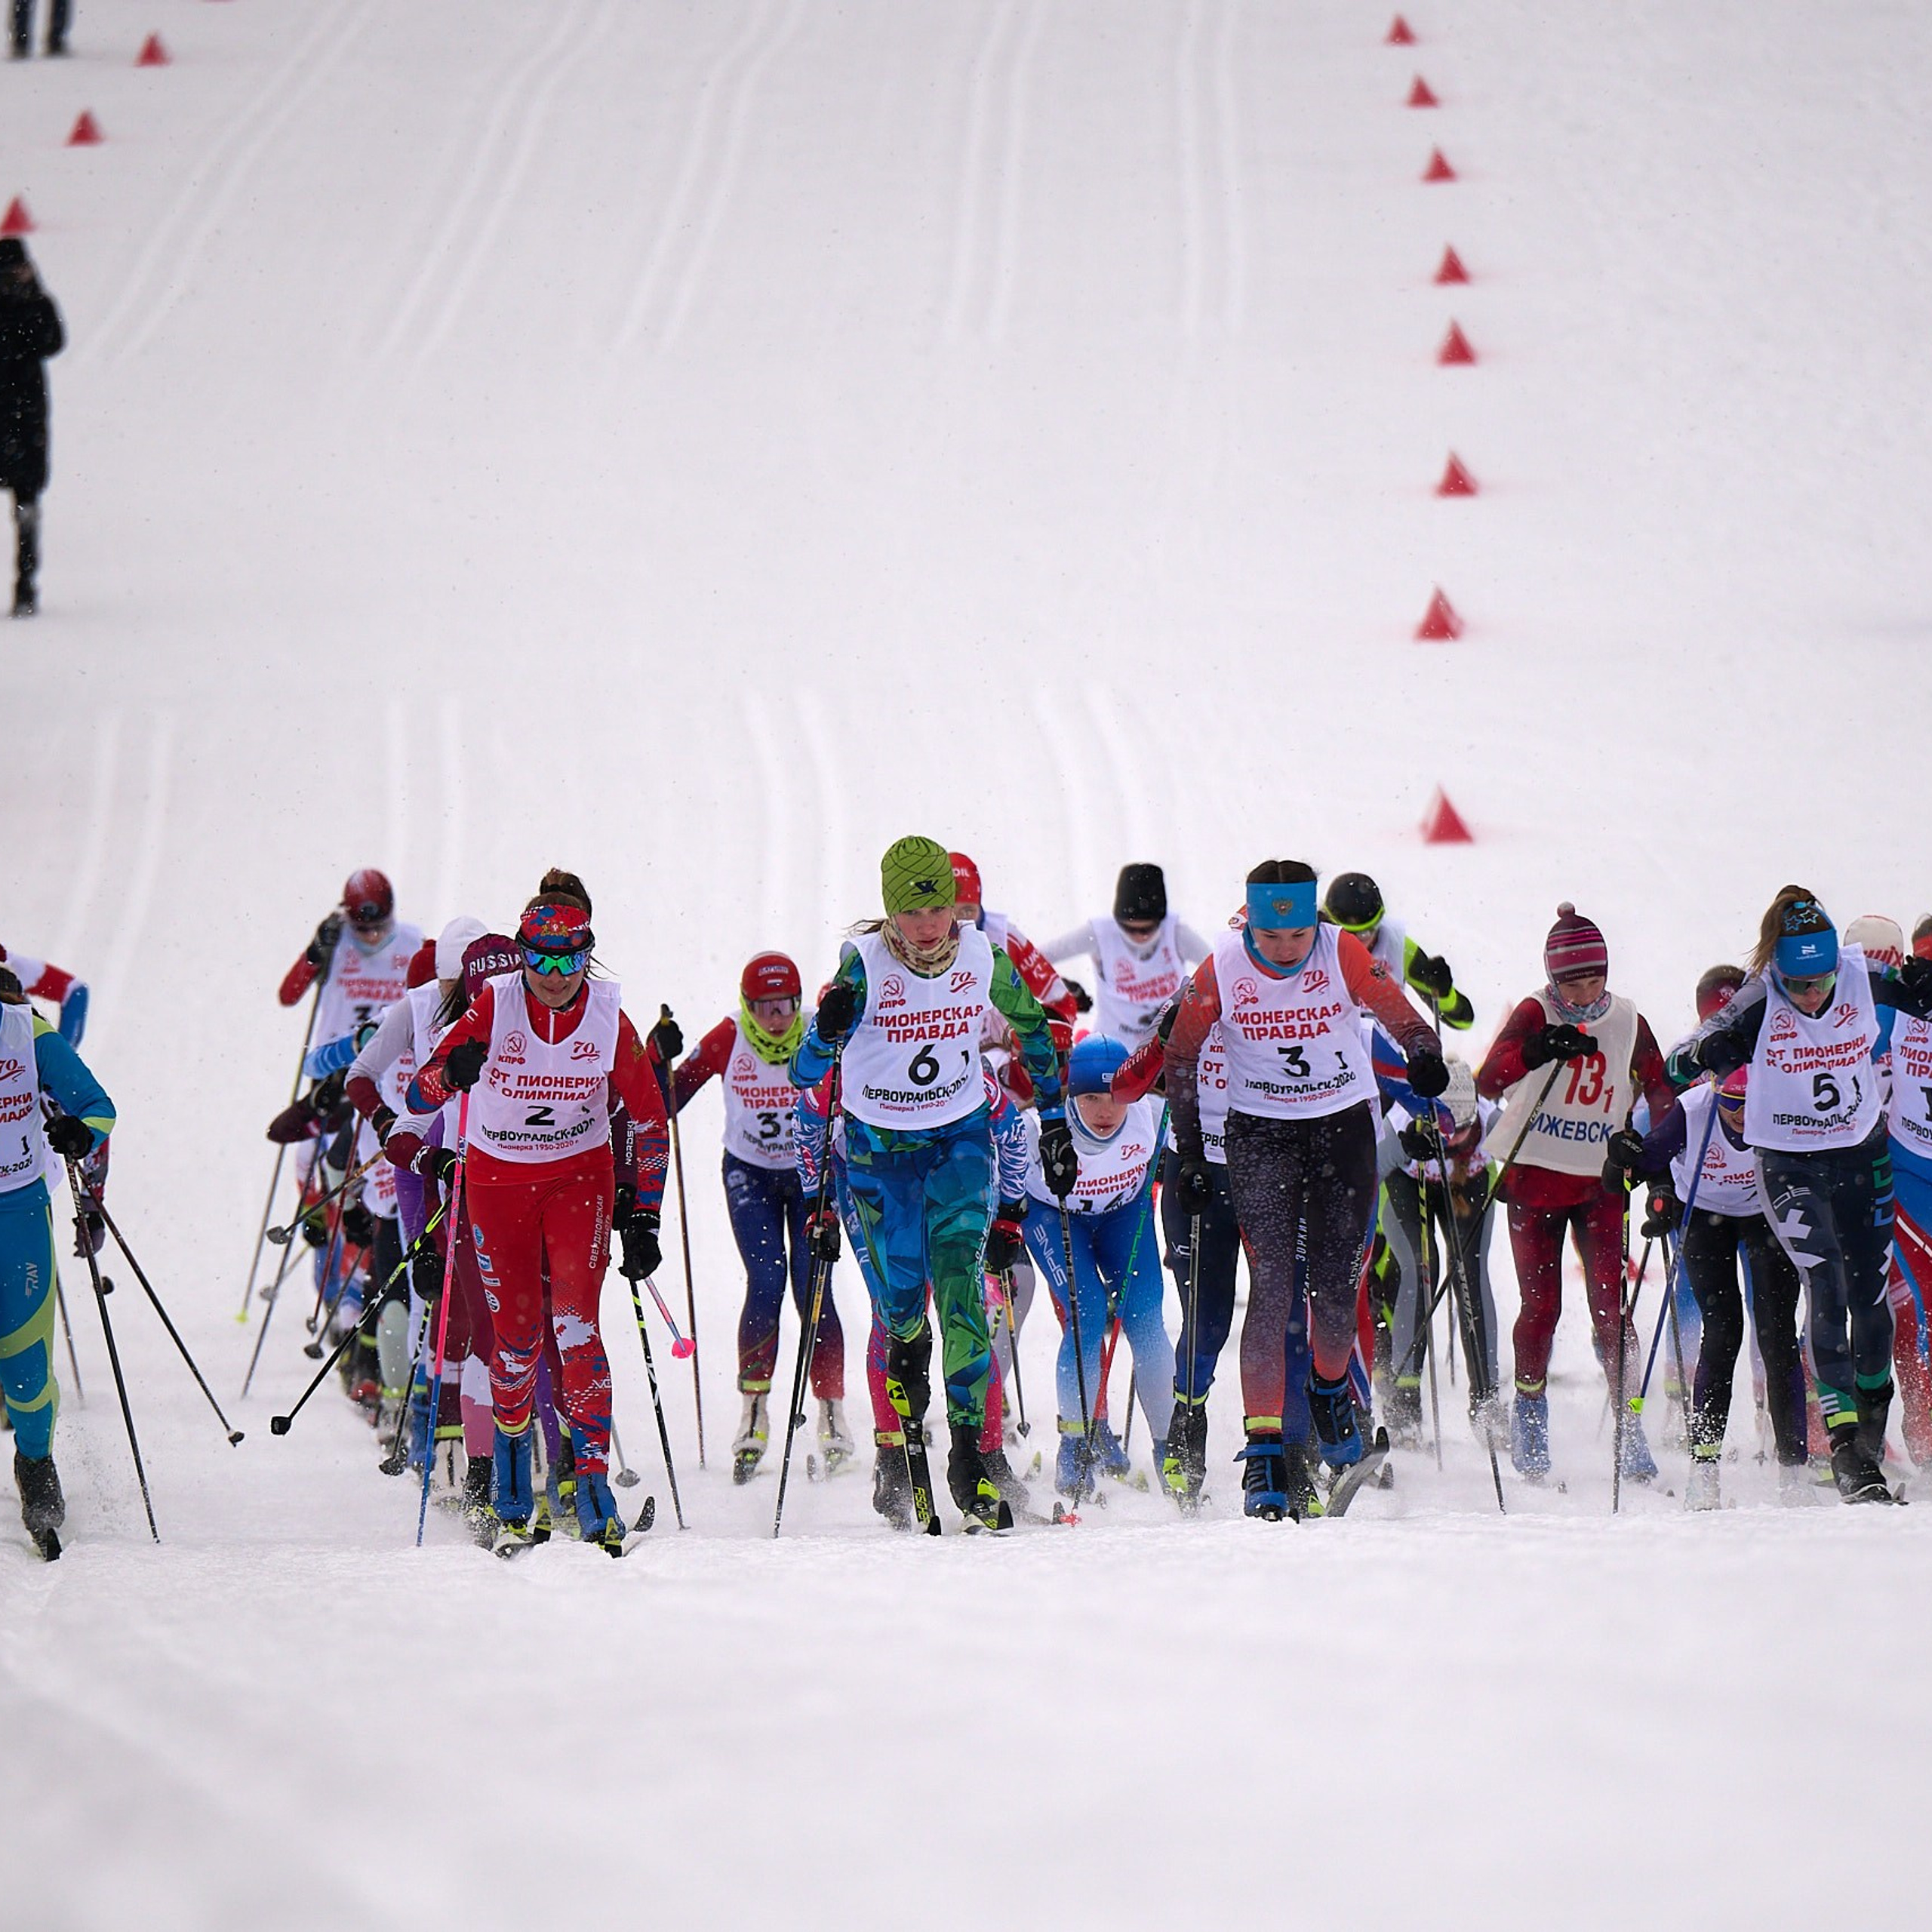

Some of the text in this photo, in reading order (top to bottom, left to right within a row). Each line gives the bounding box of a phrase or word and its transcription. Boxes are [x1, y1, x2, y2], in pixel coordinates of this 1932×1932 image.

[469, 953, 521, 977] RUSSIA
[878, 998, 906, 1010] КПРФ
[1231, 1002, 1342, 1026] ПИОНЕРСКАЯ
[872, 1004, 984, 1028] ПИОНЕРСКАЯ
[887, 1021, 970, 1043] ПРАВДА
[1242, 1022, 1331, 1041] ПРАВДА
[1770, 1032, 1798, 1042] КПРФ
[498, 1054, 526, 1065] КПРФ
[908, 1044, 940, 1086] 6
[1277, 1045, 1311, 1077] 3
[1767, 1048, 1786, 1060] ОТ
[491, 1067, 510, 1083] ОТ
[1203, 1060, 1224, 1074] ОТ
[1564, 1050, 1606, 1106] 13
[731, 1085, 803, 1097] ПИОНЕРС
[1813, 1073, 1841, 1112] 5
[525, 1106, 555, 1126] 2
[1530, 1112, 1614, 1143] ИЖЕВСК
[589, 1195, 605, 1269] СВЕРДЛОВСКАЯ
[1033, 1224, 1067, 1287] SPINE
